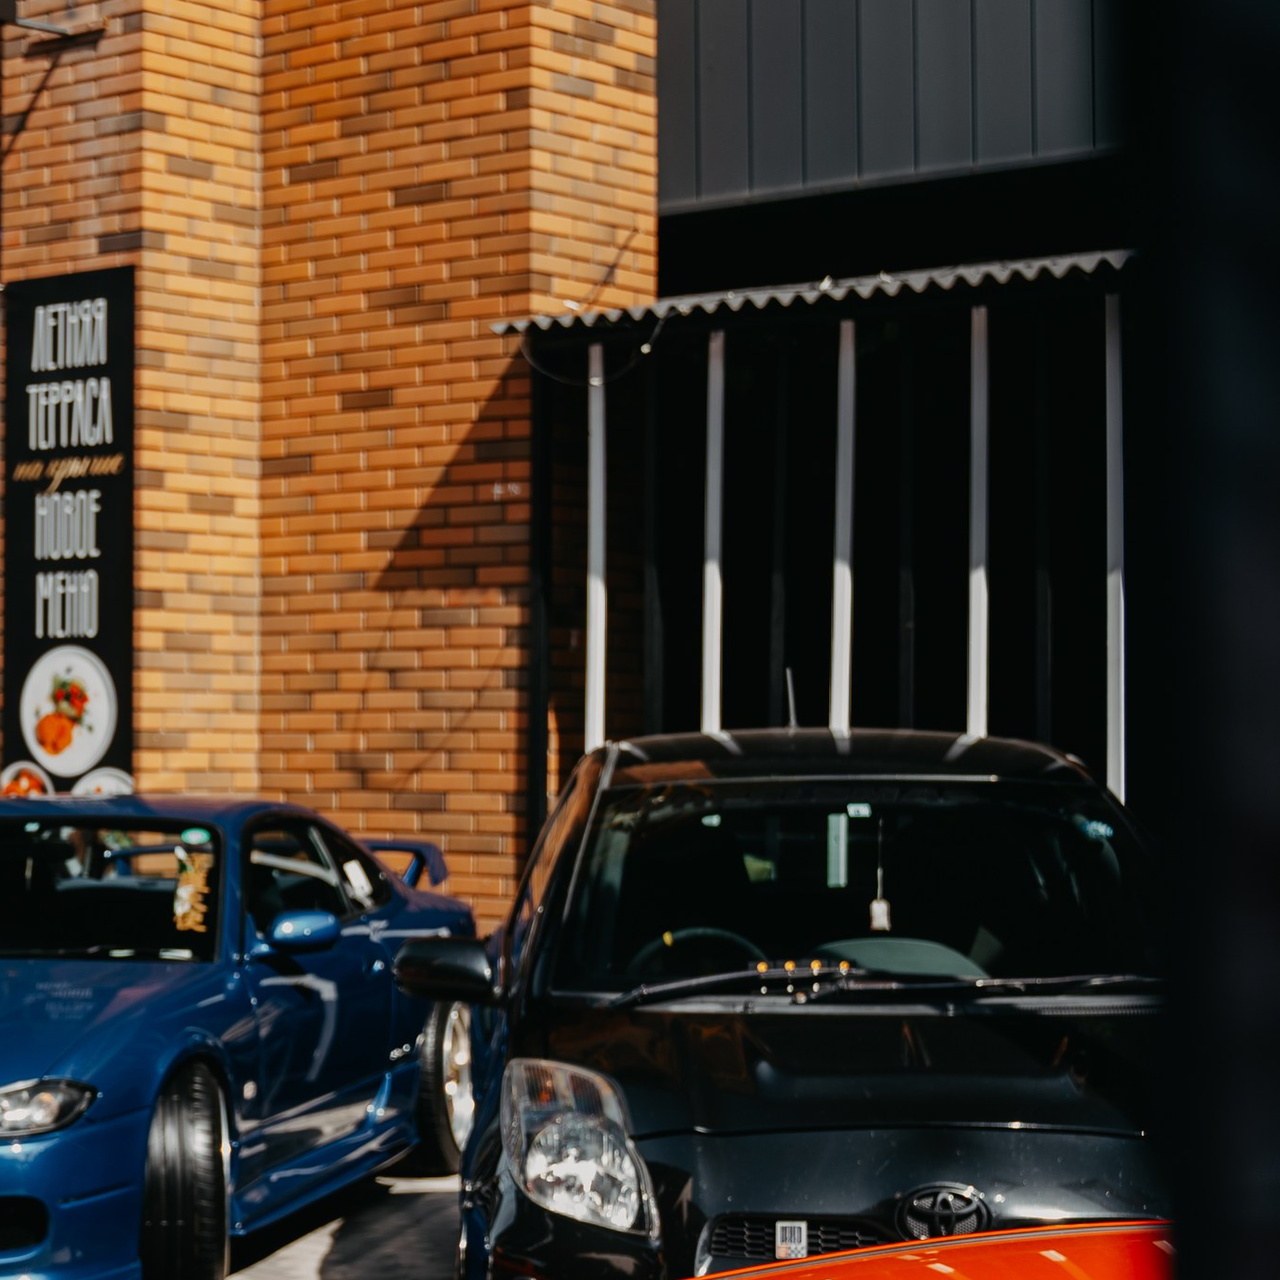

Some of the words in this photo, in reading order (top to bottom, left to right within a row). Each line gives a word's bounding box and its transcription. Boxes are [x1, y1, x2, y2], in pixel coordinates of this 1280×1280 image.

[31, 297, 107, 372] ЛЕТНЯЯ
[26, 376, 114, 451] ТЕРРАСА
[34, 489, 102, 561] НОВОЕ
[35, 568, 99, 639] МЕНЮ
